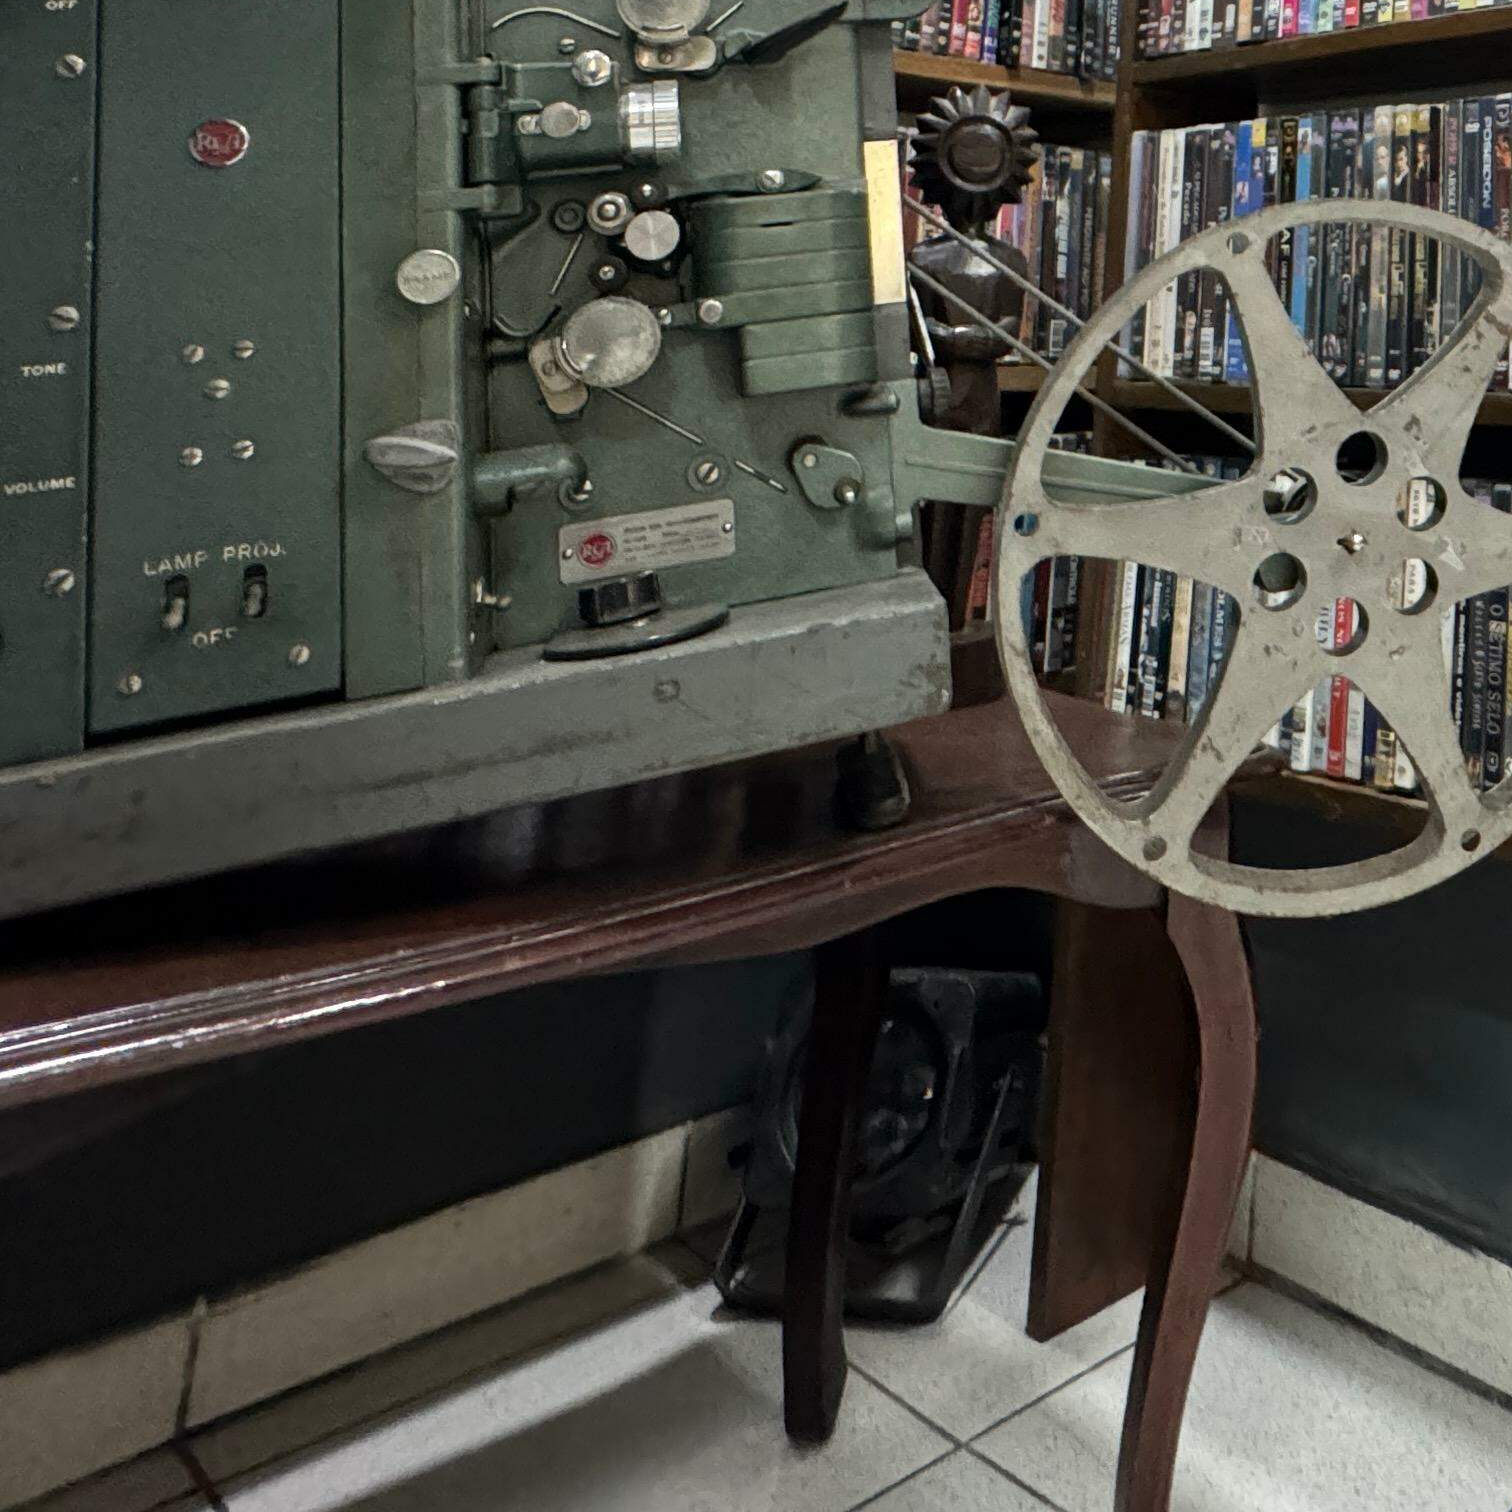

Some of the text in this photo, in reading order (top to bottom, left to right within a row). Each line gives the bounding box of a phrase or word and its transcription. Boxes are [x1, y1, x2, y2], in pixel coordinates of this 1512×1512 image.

[45, 0, 78, 11] OFF
[1482, 116, 1493, 209] POSEIDON
[21, 362, 66, 377] TONE
[3, 476, 76, 495] VOLUME
[143, 550, 209, 576] LAMP
[192, 626, 239, 649] OFF
[1487, 605, 1502, 734] O SELO
